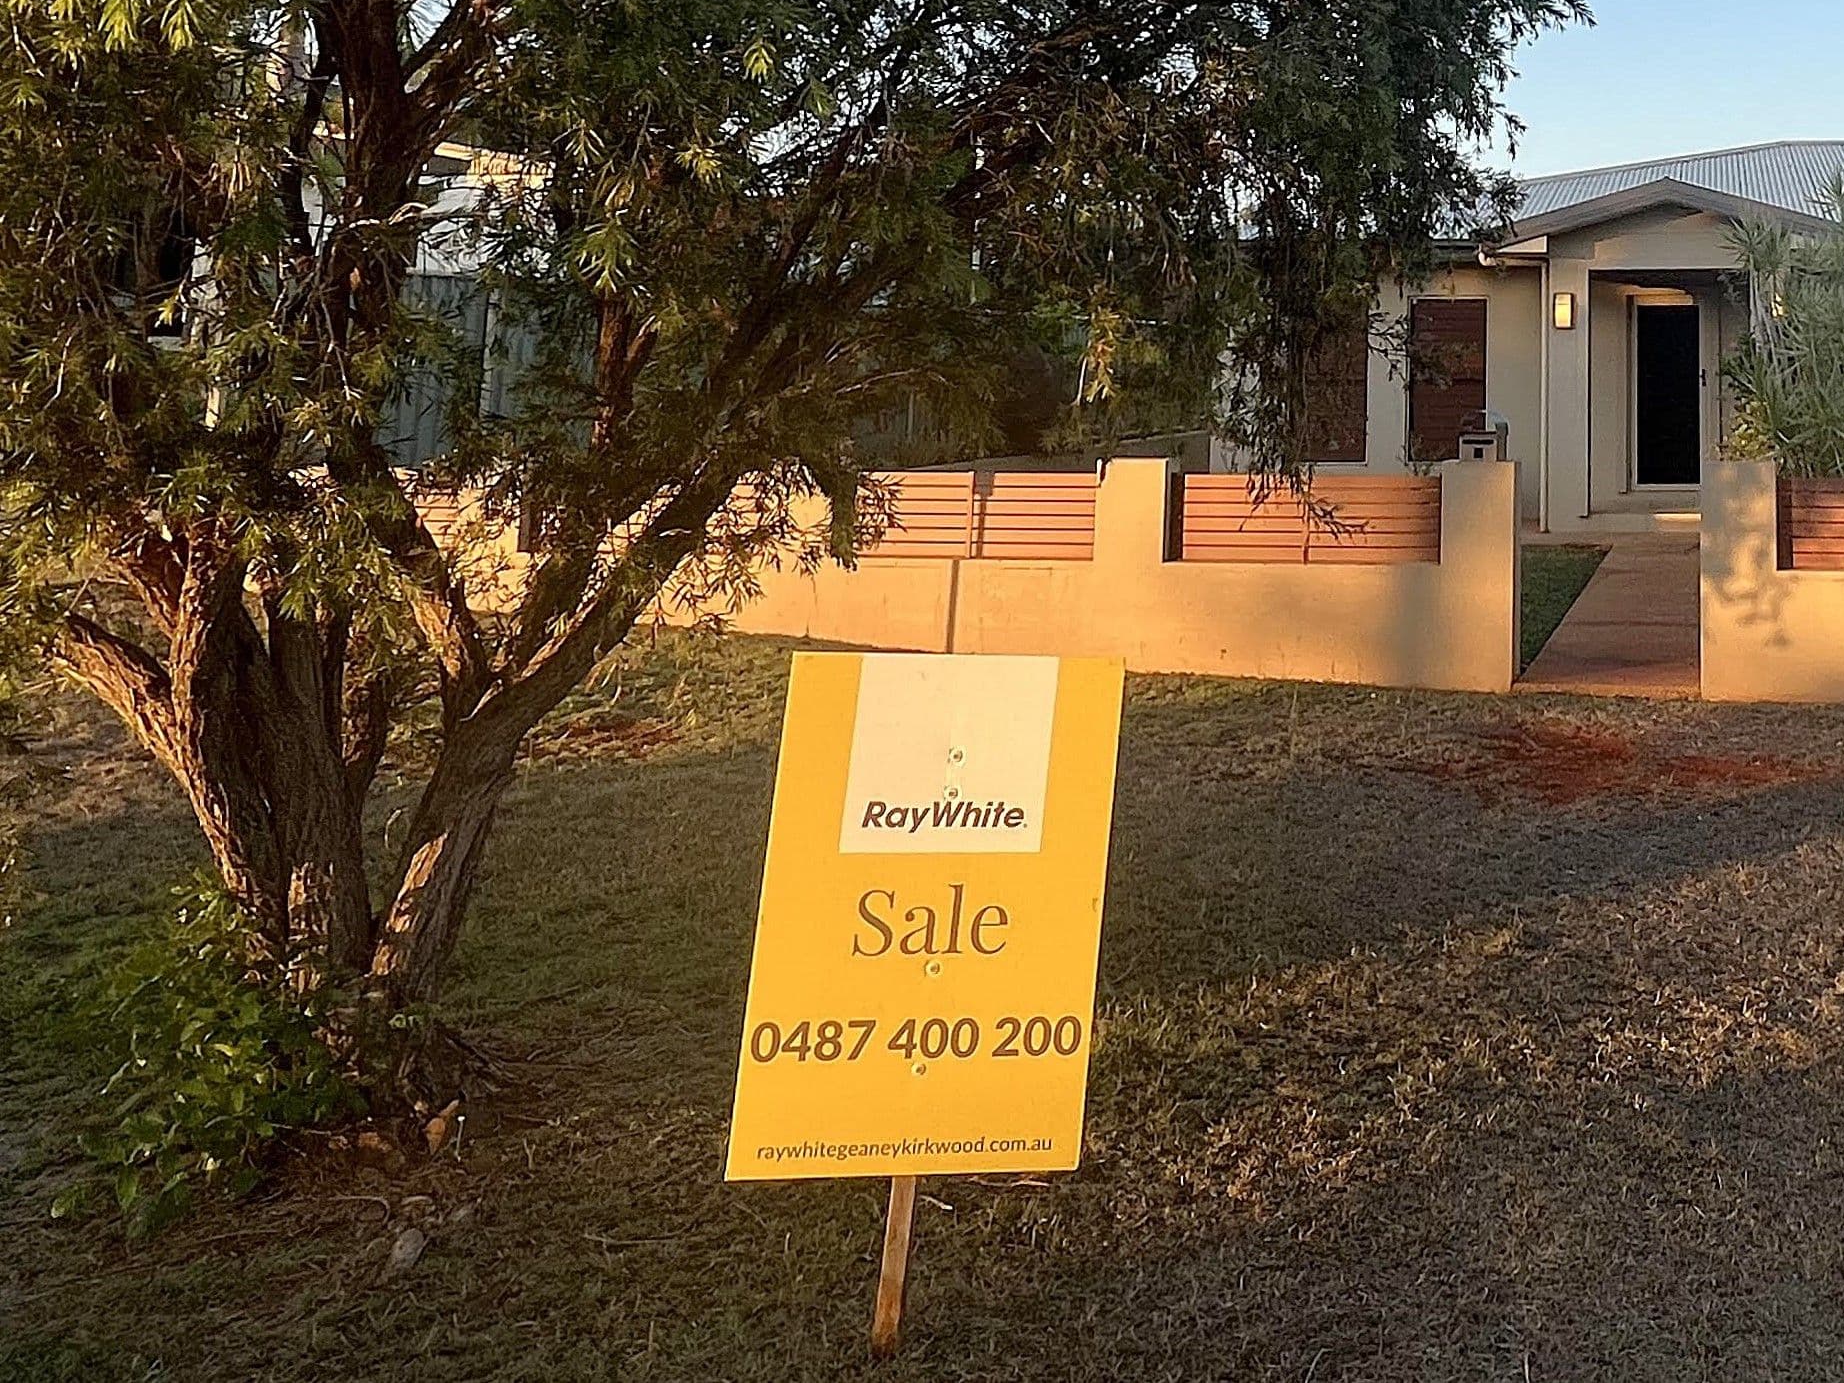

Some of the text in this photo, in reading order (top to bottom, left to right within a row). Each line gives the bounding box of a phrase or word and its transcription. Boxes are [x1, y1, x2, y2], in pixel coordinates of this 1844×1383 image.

[851, 884, 1008, 958] Sale
[750, 1015, 1081, 1063] 0487 400 200
[756, 1135, 1053, 1161] raywhitegeaneykirkwood.com.au
